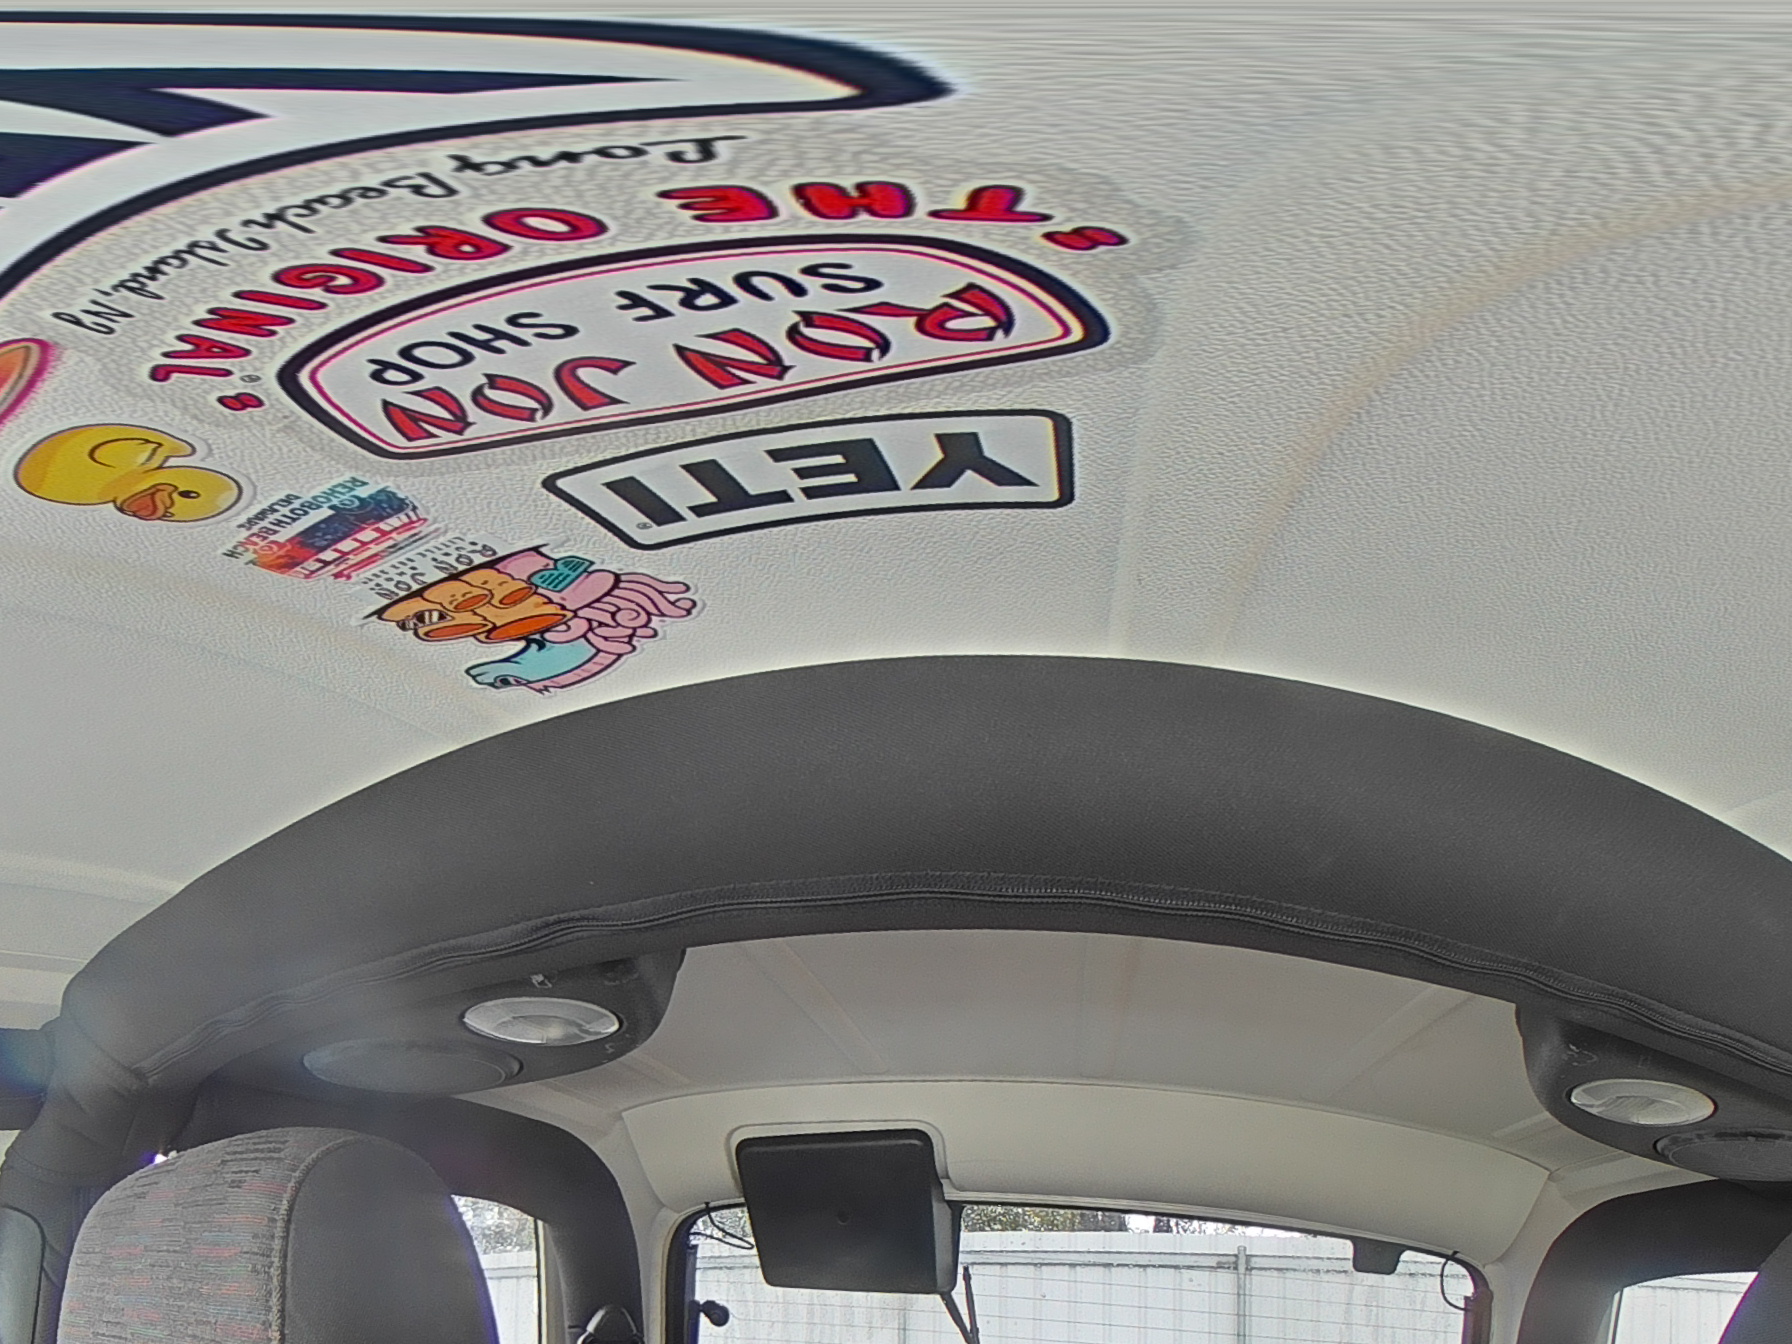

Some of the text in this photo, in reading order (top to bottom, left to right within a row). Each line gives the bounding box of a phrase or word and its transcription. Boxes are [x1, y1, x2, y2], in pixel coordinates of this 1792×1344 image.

[52, 136, 749, 335] Long Beach Island, NJ
[369, 262, 885, 386] SURF SHOP
[380, 282, 1015, 443] RON JON
[222, 476, 369, 560] REHOBOTH BEACH
[237, 493, 303, 531] DELAWARE
[604, 431, 1041, 529] YETI
[375, 571, 429, 600] JON
[433, 543, 498, 575] RON
